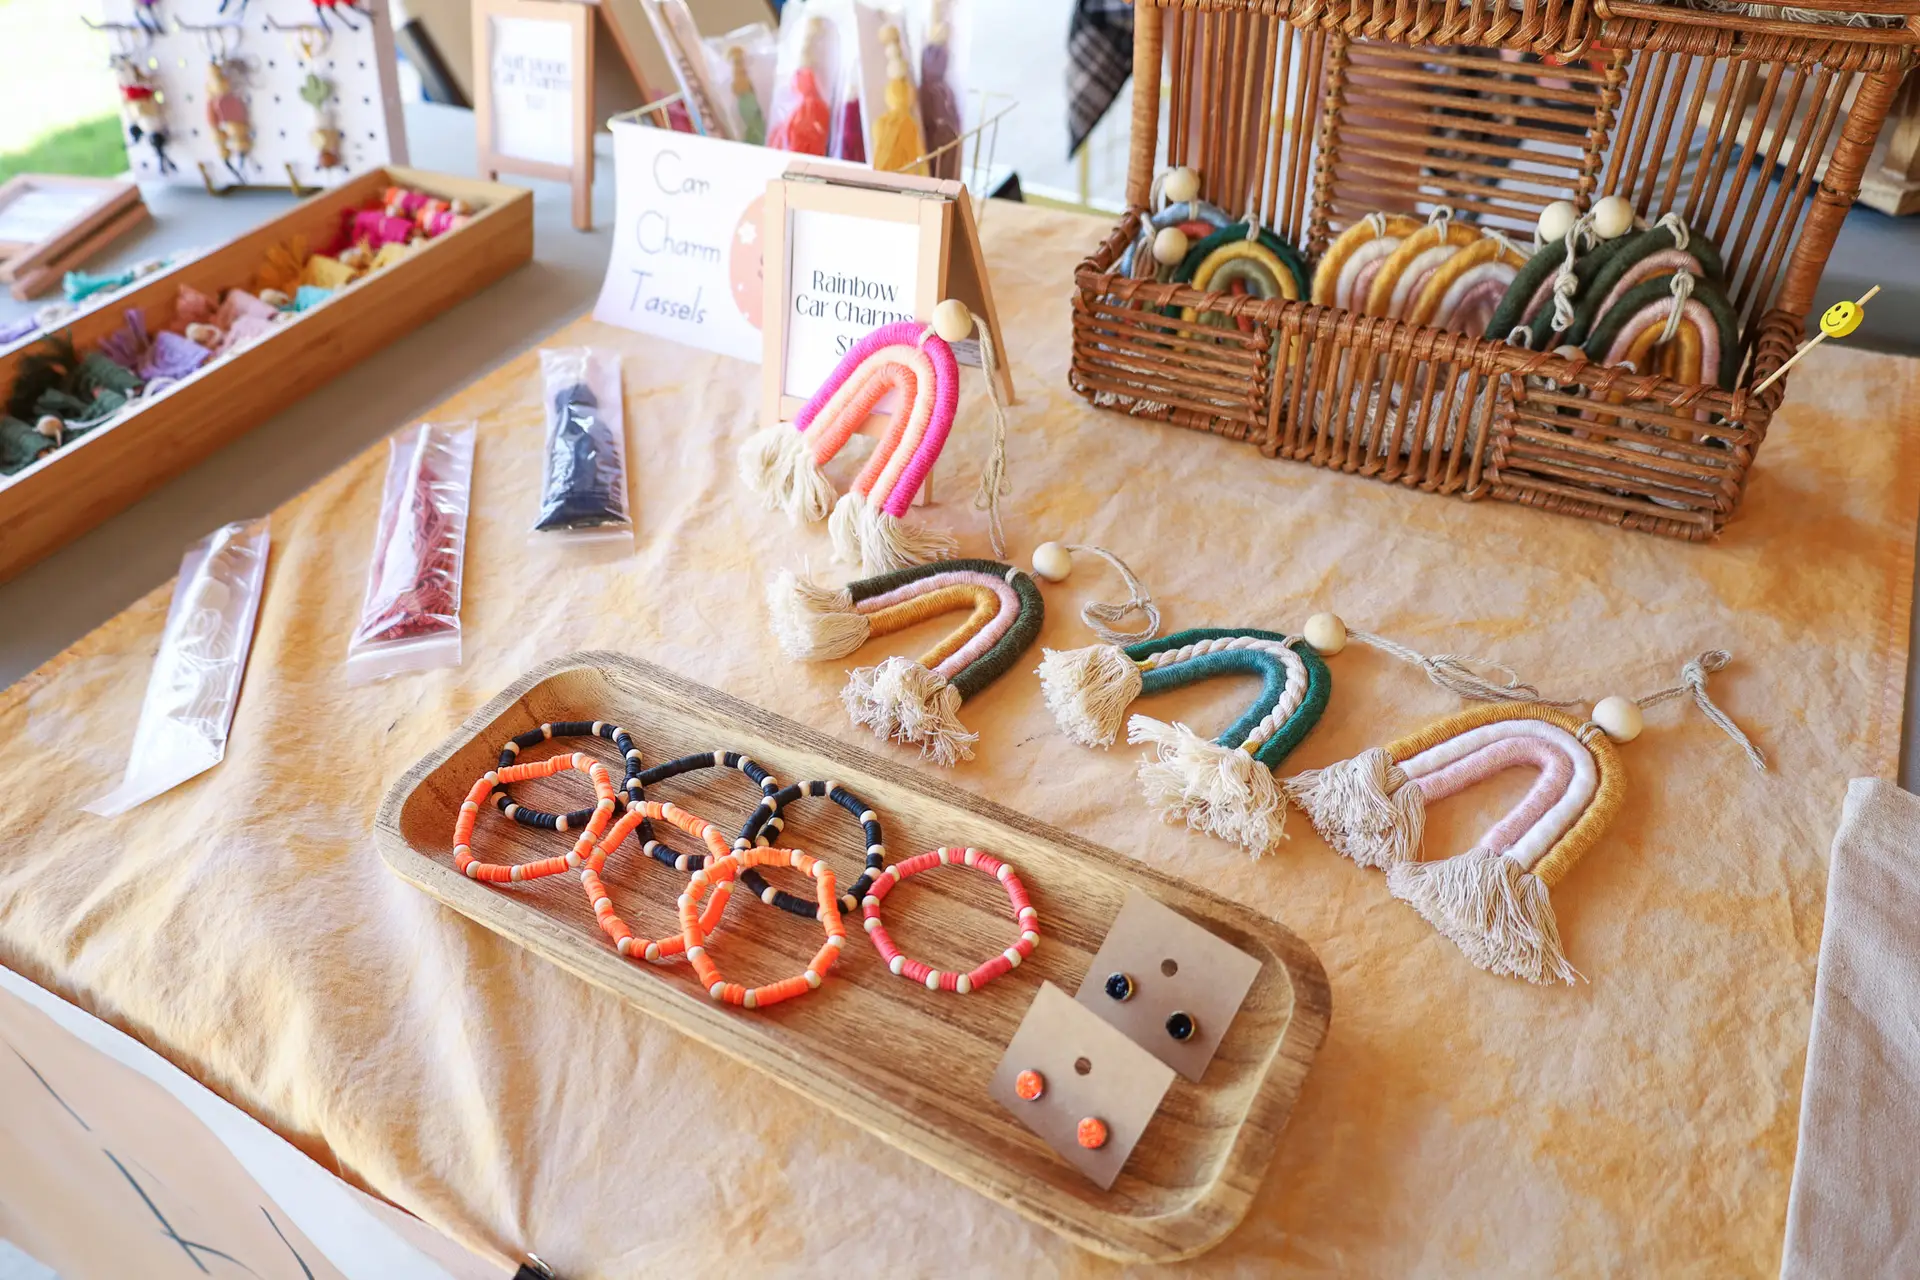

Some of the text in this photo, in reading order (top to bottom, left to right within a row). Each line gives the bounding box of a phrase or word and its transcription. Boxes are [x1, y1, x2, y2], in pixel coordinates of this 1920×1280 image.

[653, 149, 710, 195] Car
[636, 210, 721, 263] Charm
[629, 268, 707, 324] Tassels
[796, 293, 829, 318] Car
[812, 269, 899, 302] Rainbow
